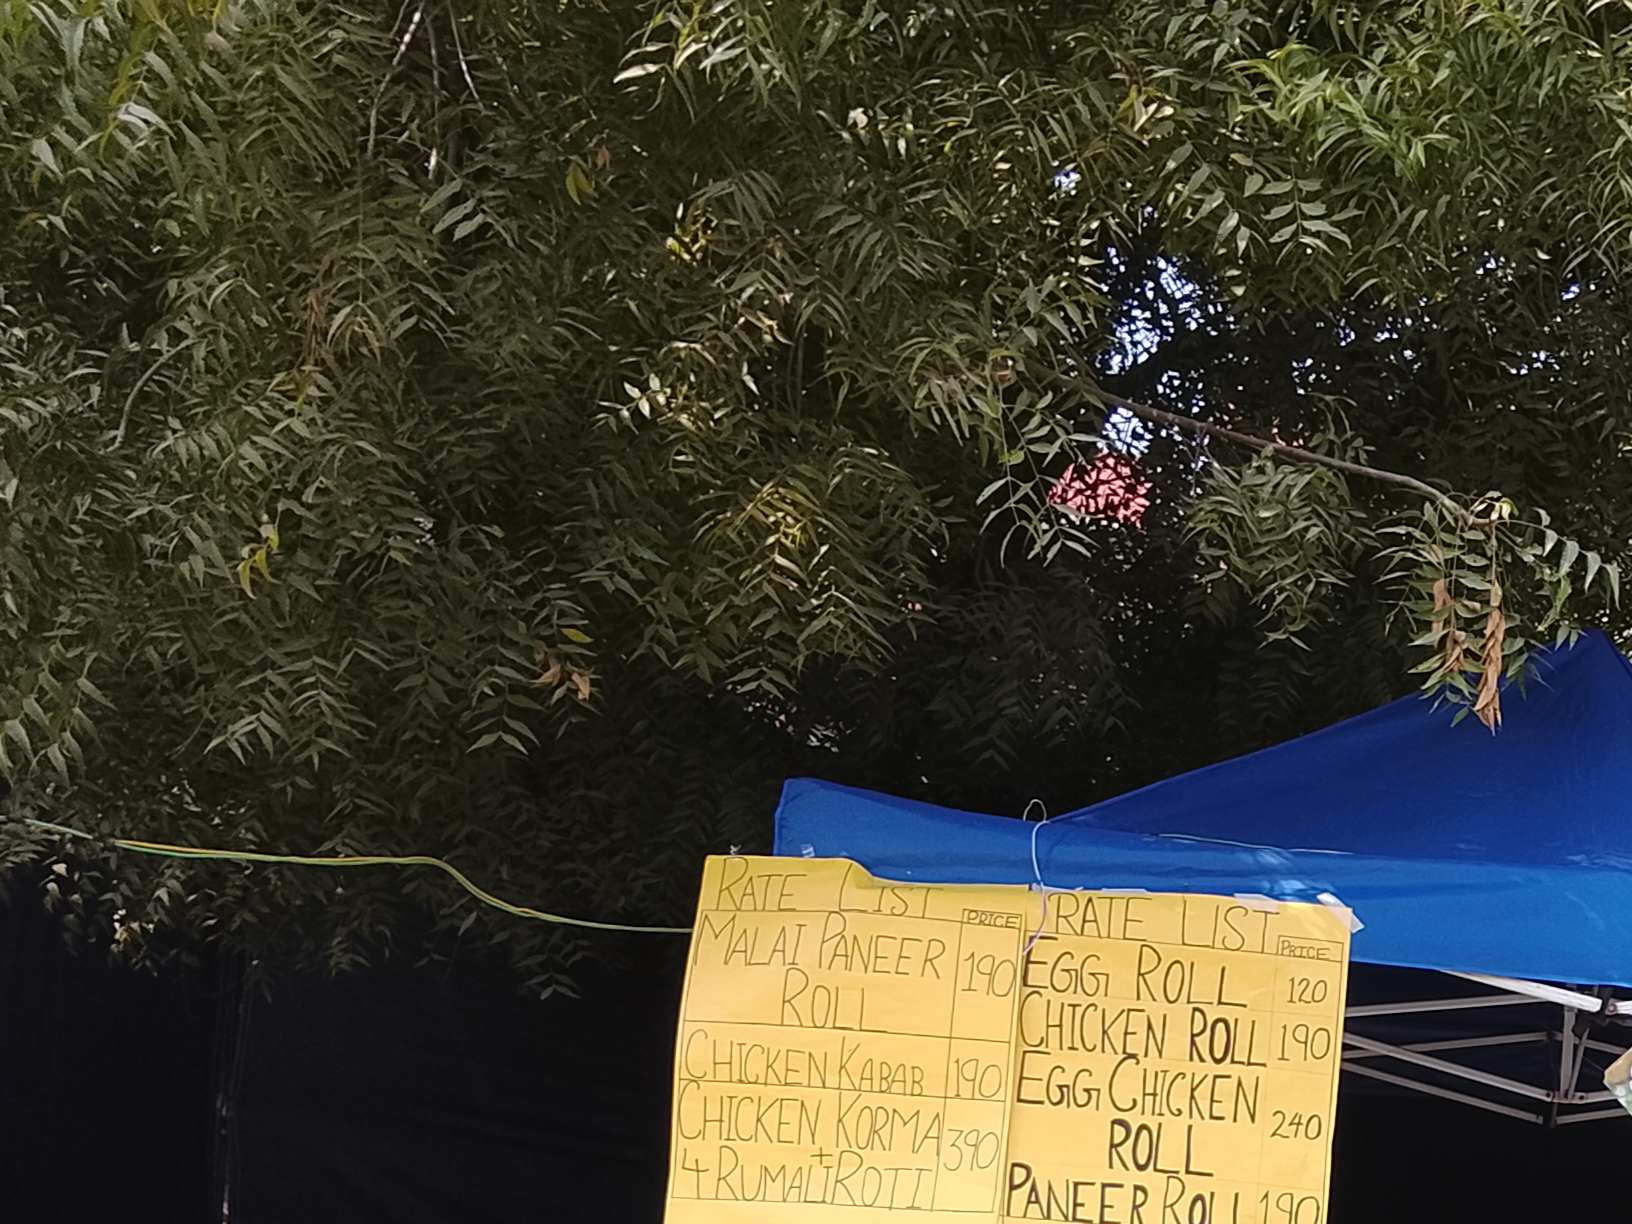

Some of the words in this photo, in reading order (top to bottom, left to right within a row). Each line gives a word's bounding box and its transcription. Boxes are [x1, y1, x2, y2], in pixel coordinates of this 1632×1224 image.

[718, 857, 806, 911] RATE
[838, 862, 943, 918] LIST
[966, 911, 1020, 928] PRICE
[1048, 892, 1152, 941] RATE
[1181, 895, 1280, 952] LIST
[1280, 940, 1330, 961] PRICE
[694, 913, 806, 966] MALAI
[819, 911, 945, 979] PANEER
[962, 952, 1016, 997] 190
[1022, 936, 1110, 998] EGG
[1136, 944, 1248, 1008] ROLL
[1287, 977, 1327, 1004] 120
[782, 969, 887, 1032] ROLL
[1020, 991, 1167, 1058] CHICKEN
[1190, 1006, 1267, 1067] ROLL
[1278, 1023, 1330, 1062] 190
[685, 1029, 826, 1088] CHICKEN
[840, 1037, 924, 1096] KABAB
[954, 1058, 1001, 1099] 190
[1017, 1050, 1100, 1111] EGG
[1109, 1056, 1259, 1124] CHICKEN
[678, 1081, 822, 1146] CHICKEN
[835, 1093, 941, 1156] KORMA
[945, 1129, 999, 1171] 390
[1109, 1119, 1214, 1177] ROLL
[1270, 1111, 1322, 1140] 240
[682, 1148, 710, 1199] 4
[717, 1146, 835, 1203] RUMALI
[834, 1150, 932, 1210] ROTI
